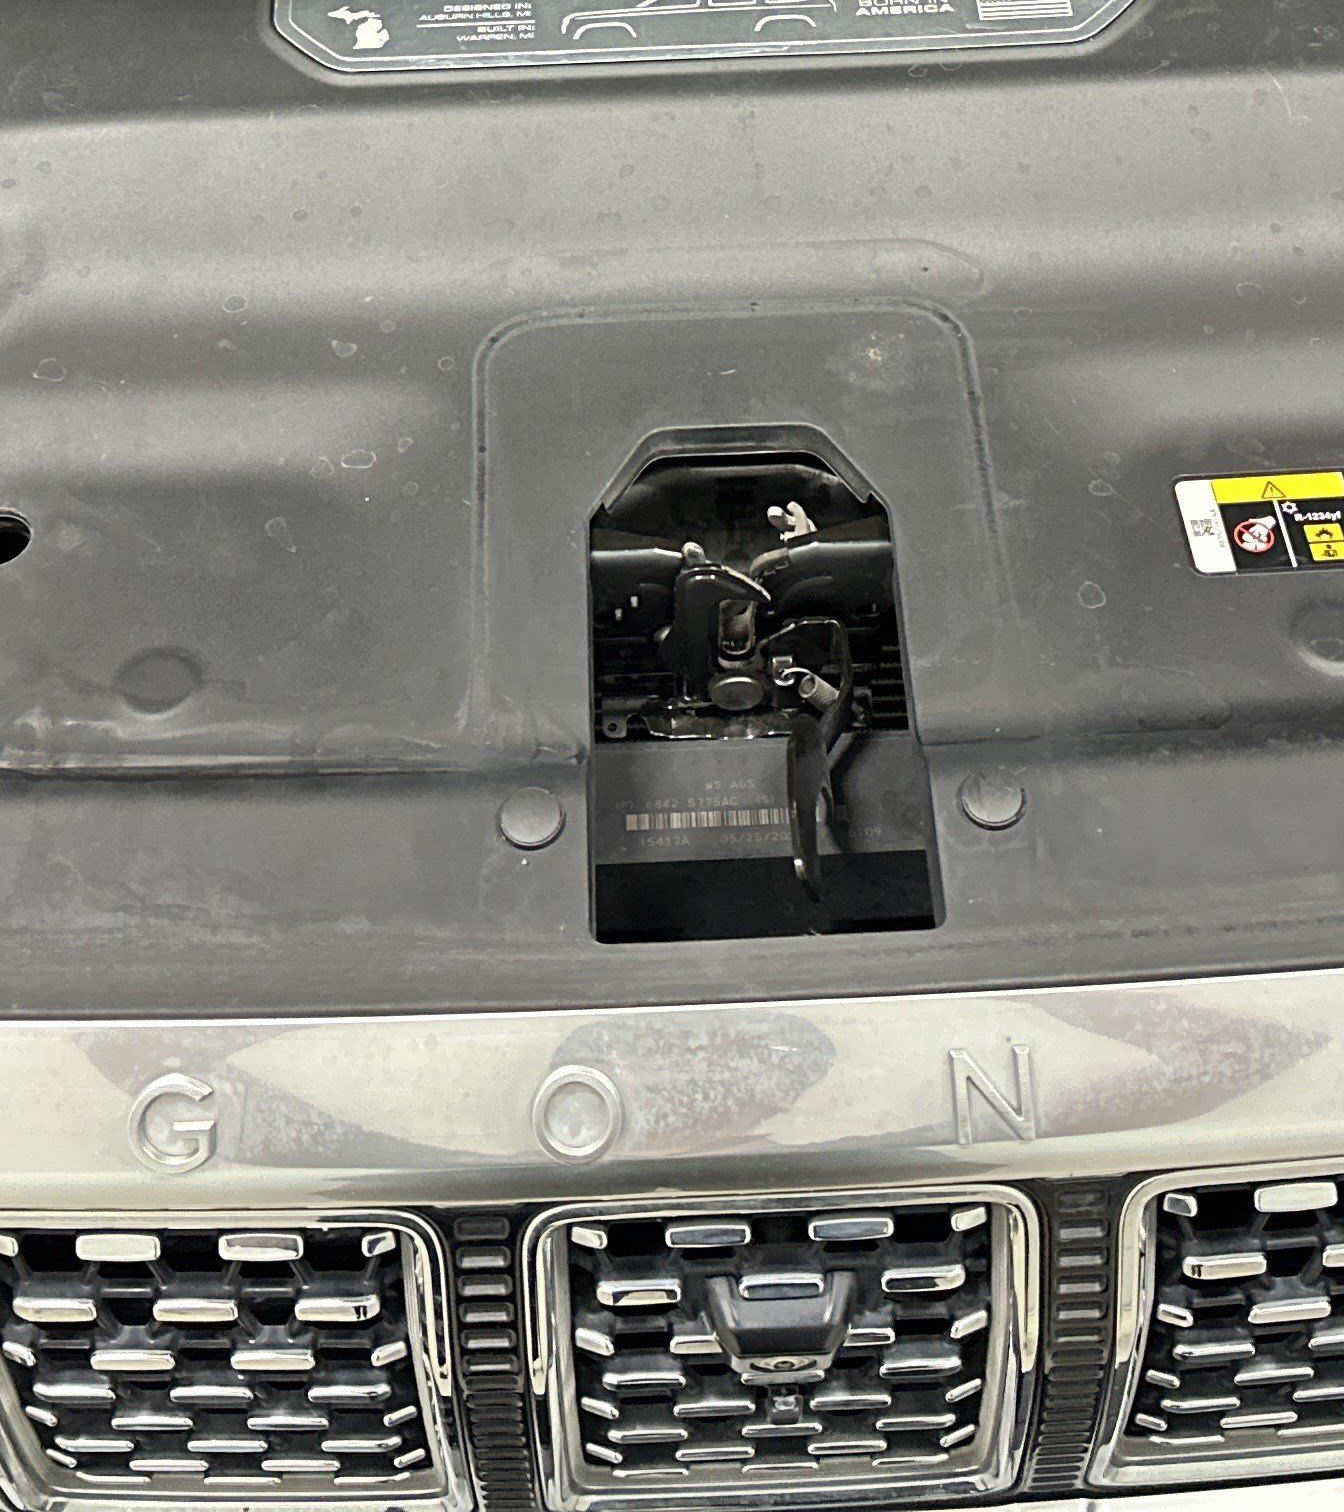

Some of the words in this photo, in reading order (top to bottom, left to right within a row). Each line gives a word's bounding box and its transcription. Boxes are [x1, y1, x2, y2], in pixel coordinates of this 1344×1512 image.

[443, 3, 511, 13] DESIGNED
[855, 3, 955, 16] AMERICA
[418, 13, 474, 21] AUBURN
[477, 24, 515, 33] BUILT
[1293, 511, 1341, 522] R-1234yf
